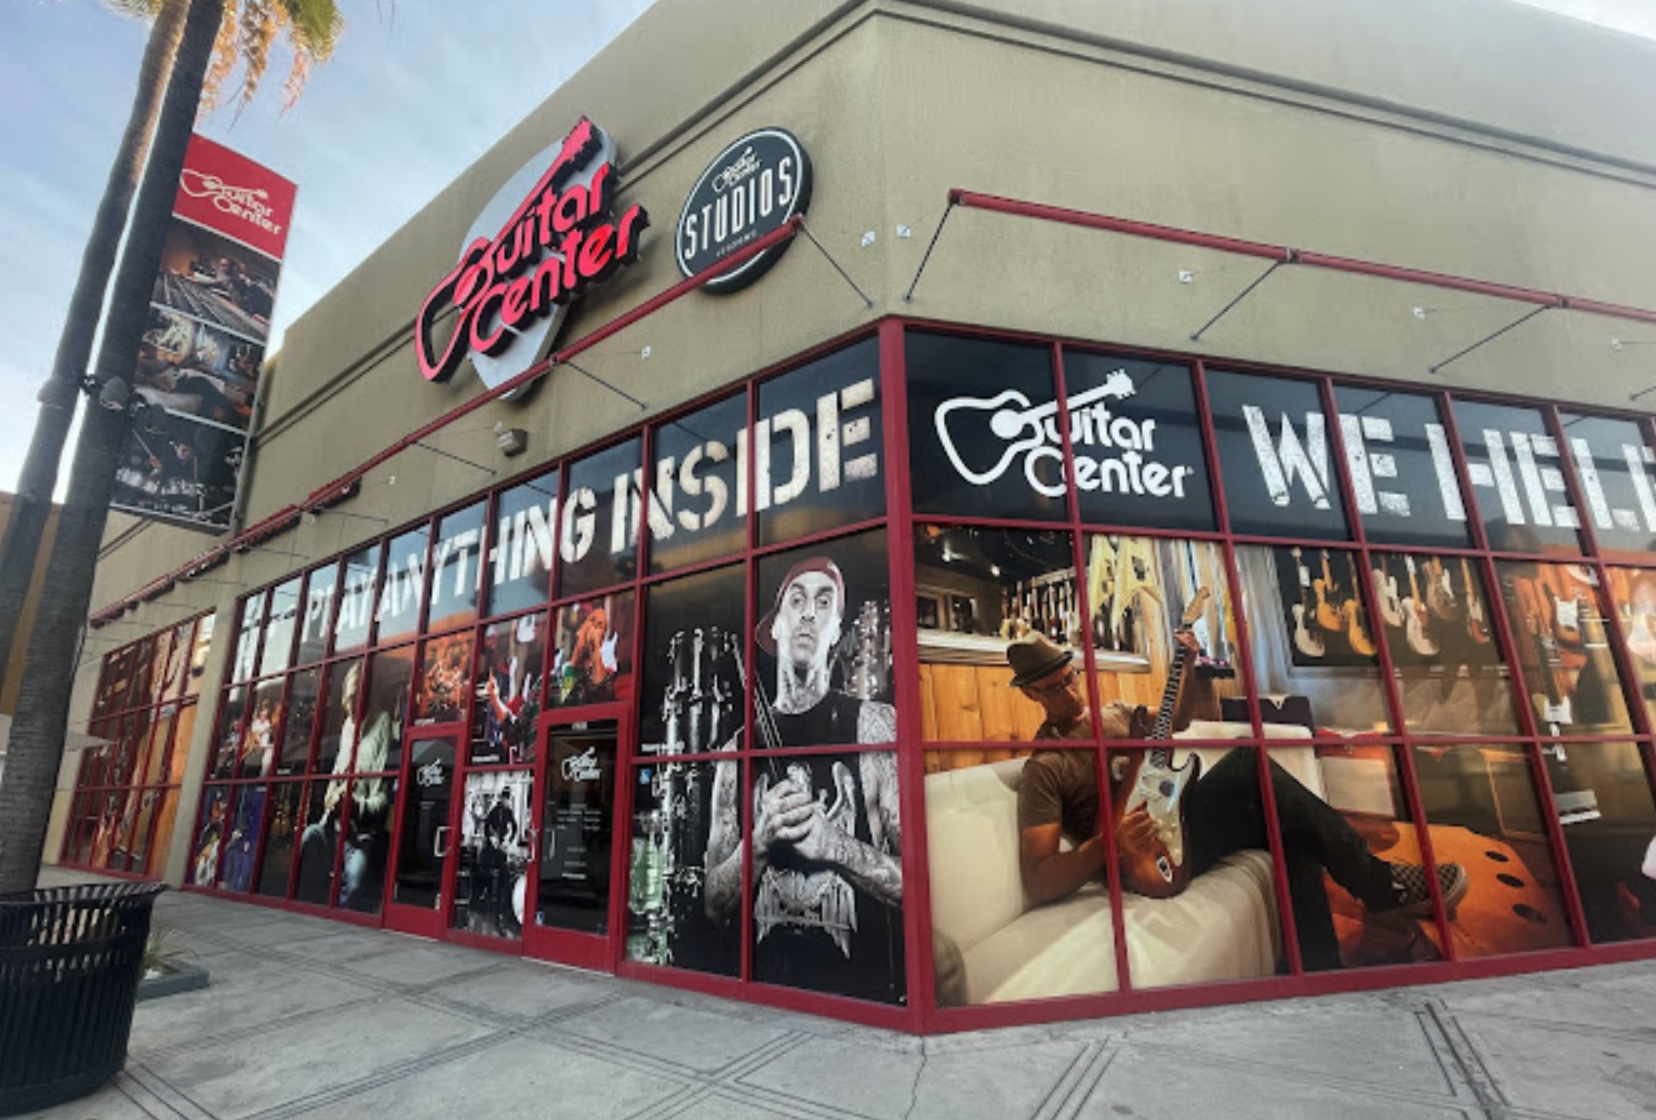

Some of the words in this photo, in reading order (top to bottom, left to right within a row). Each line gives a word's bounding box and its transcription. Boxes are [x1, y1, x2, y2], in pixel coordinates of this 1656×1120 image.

[180, 168, 273, 217] Guitar
[213, 196, 282, 235] Center
[415, 114, 612, 382] Guitar
[684, 156, 793, 260] STUDIOS
[469, 204, 642, 356] Center
[934, 369, 1156, 485] Guitar
[1024, 446, 1187, 498] Center
[1242, 404, 1410, 517] WE
[374, 486, 598, 623] ANYTHING
[611, 378, 878, 555] INSIDE
